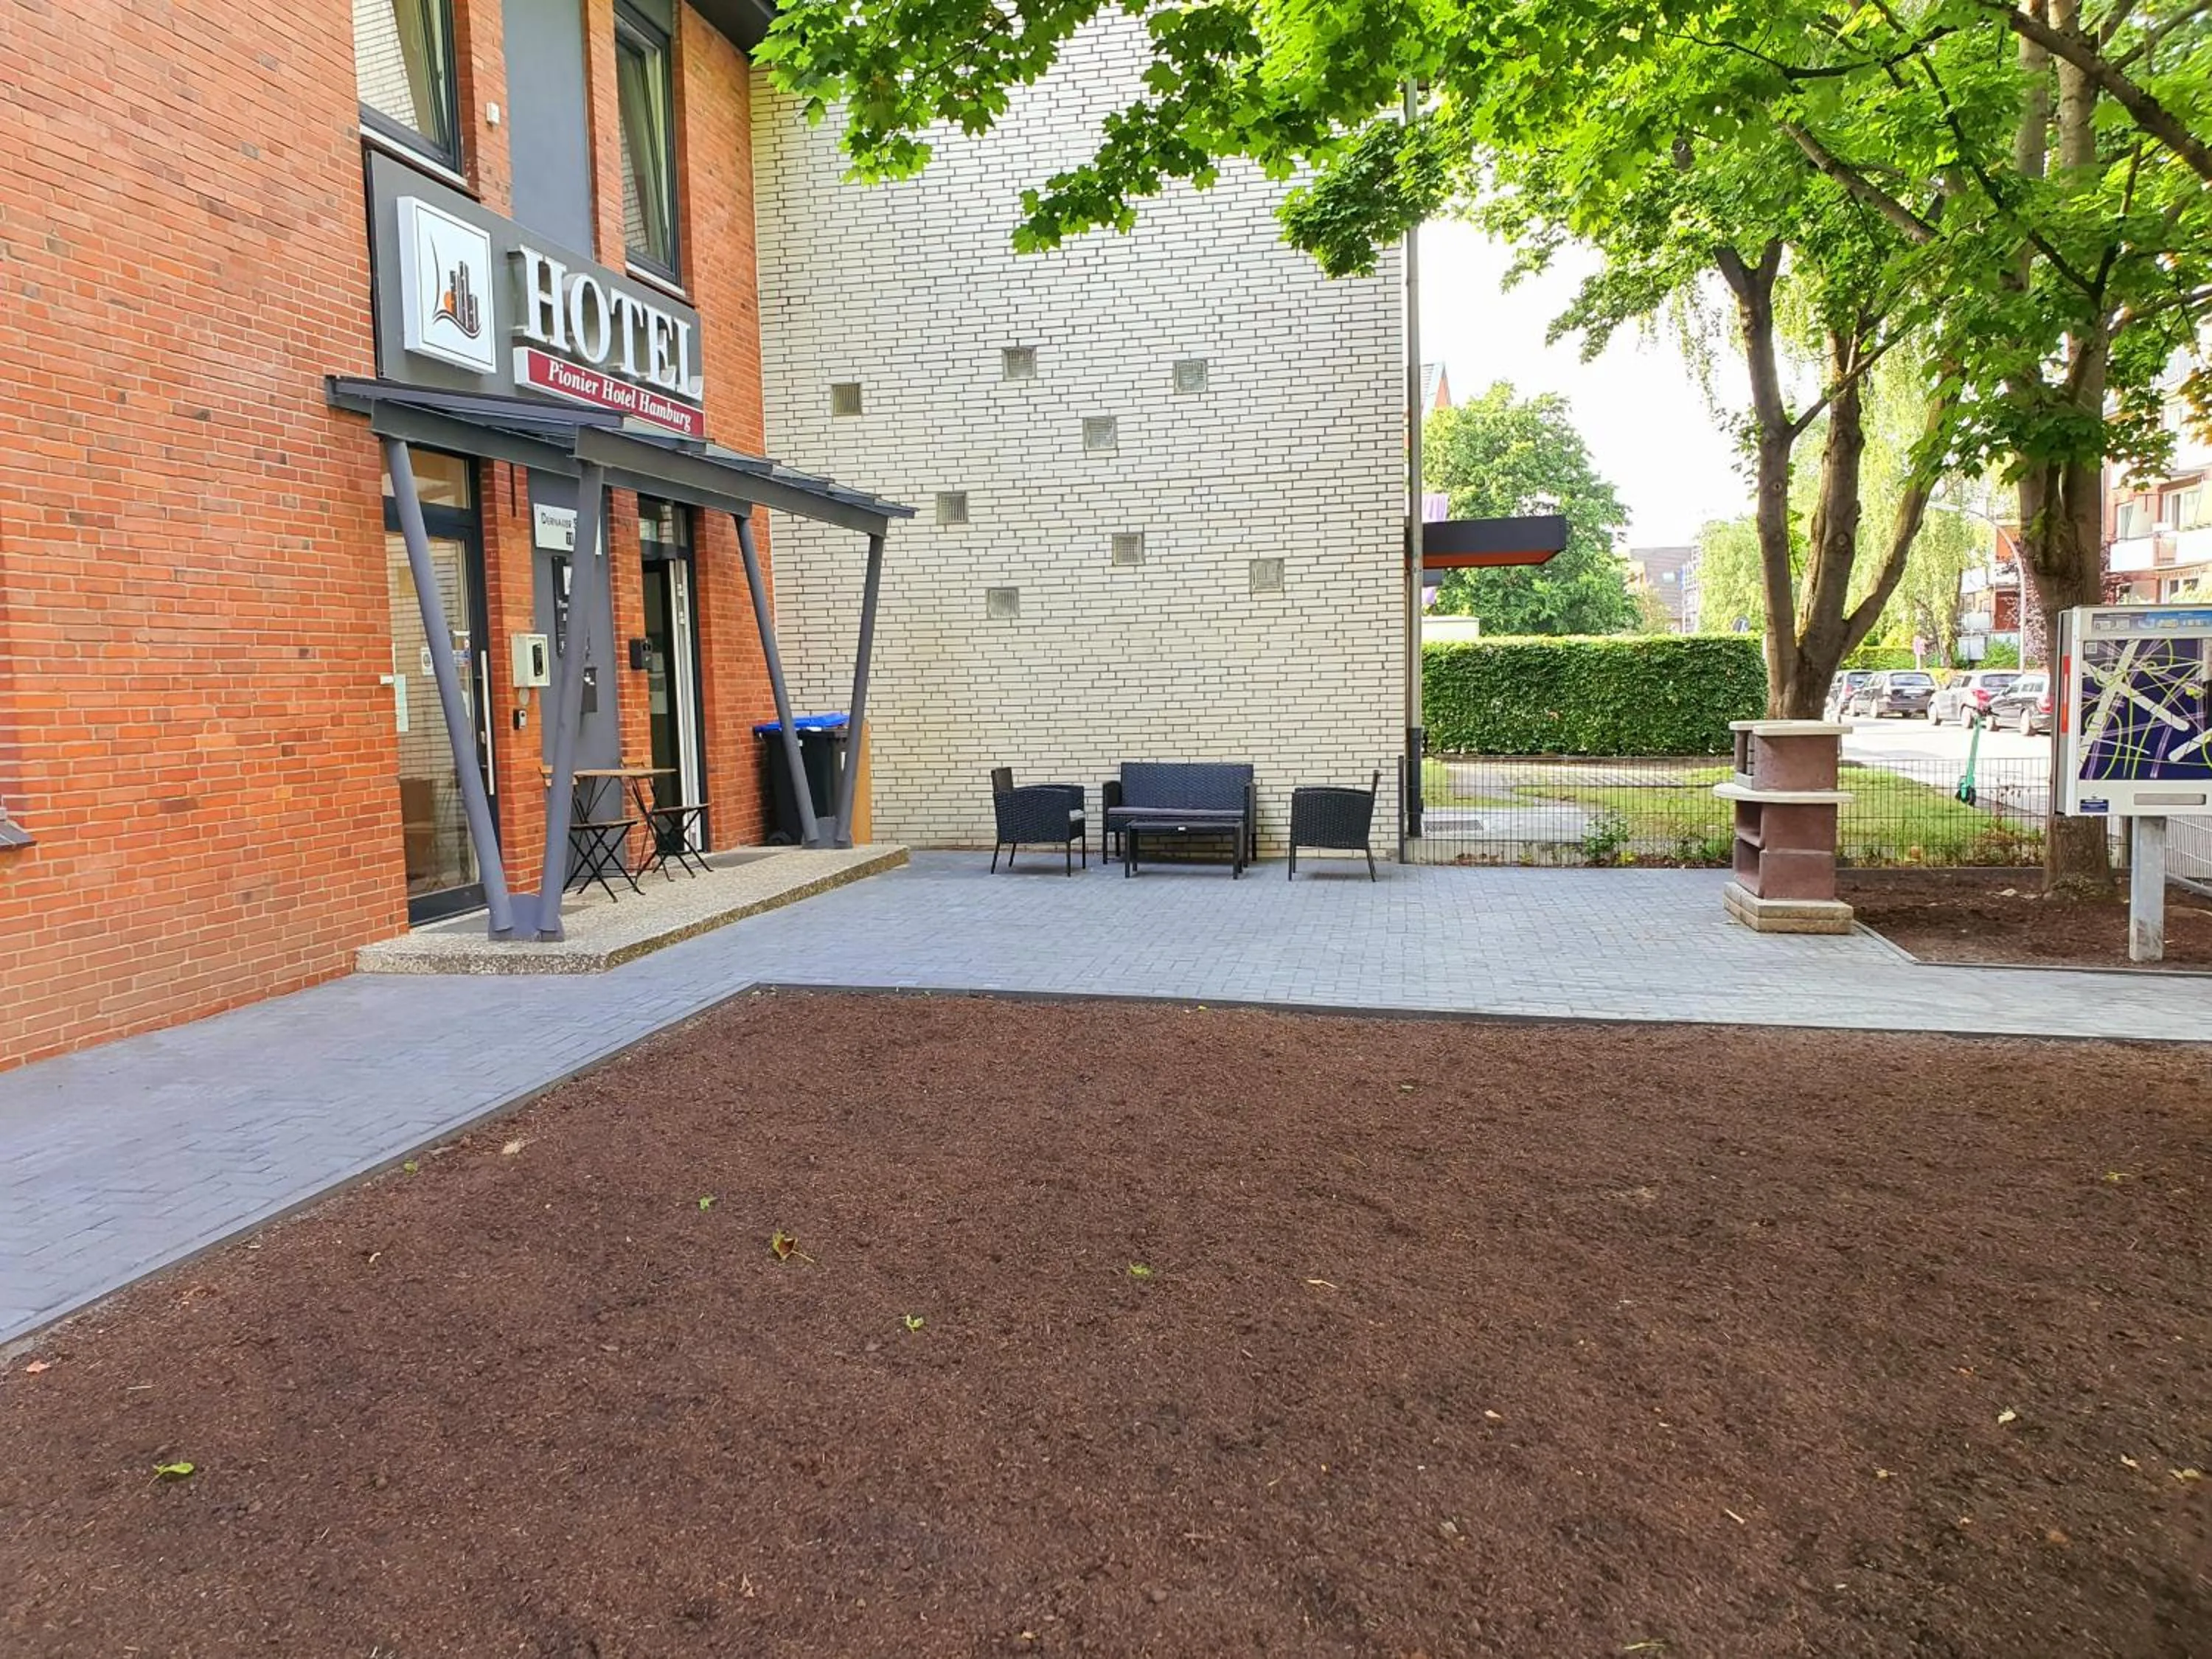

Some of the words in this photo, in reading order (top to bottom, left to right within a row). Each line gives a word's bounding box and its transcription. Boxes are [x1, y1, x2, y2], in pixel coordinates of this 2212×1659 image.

[519, 244, 703, 401] HOTEL
[548, 359, 599, 395] Pionier
[602, 379, 636, 409] Hotel
[639, 392, 692, 433] Hamburg
